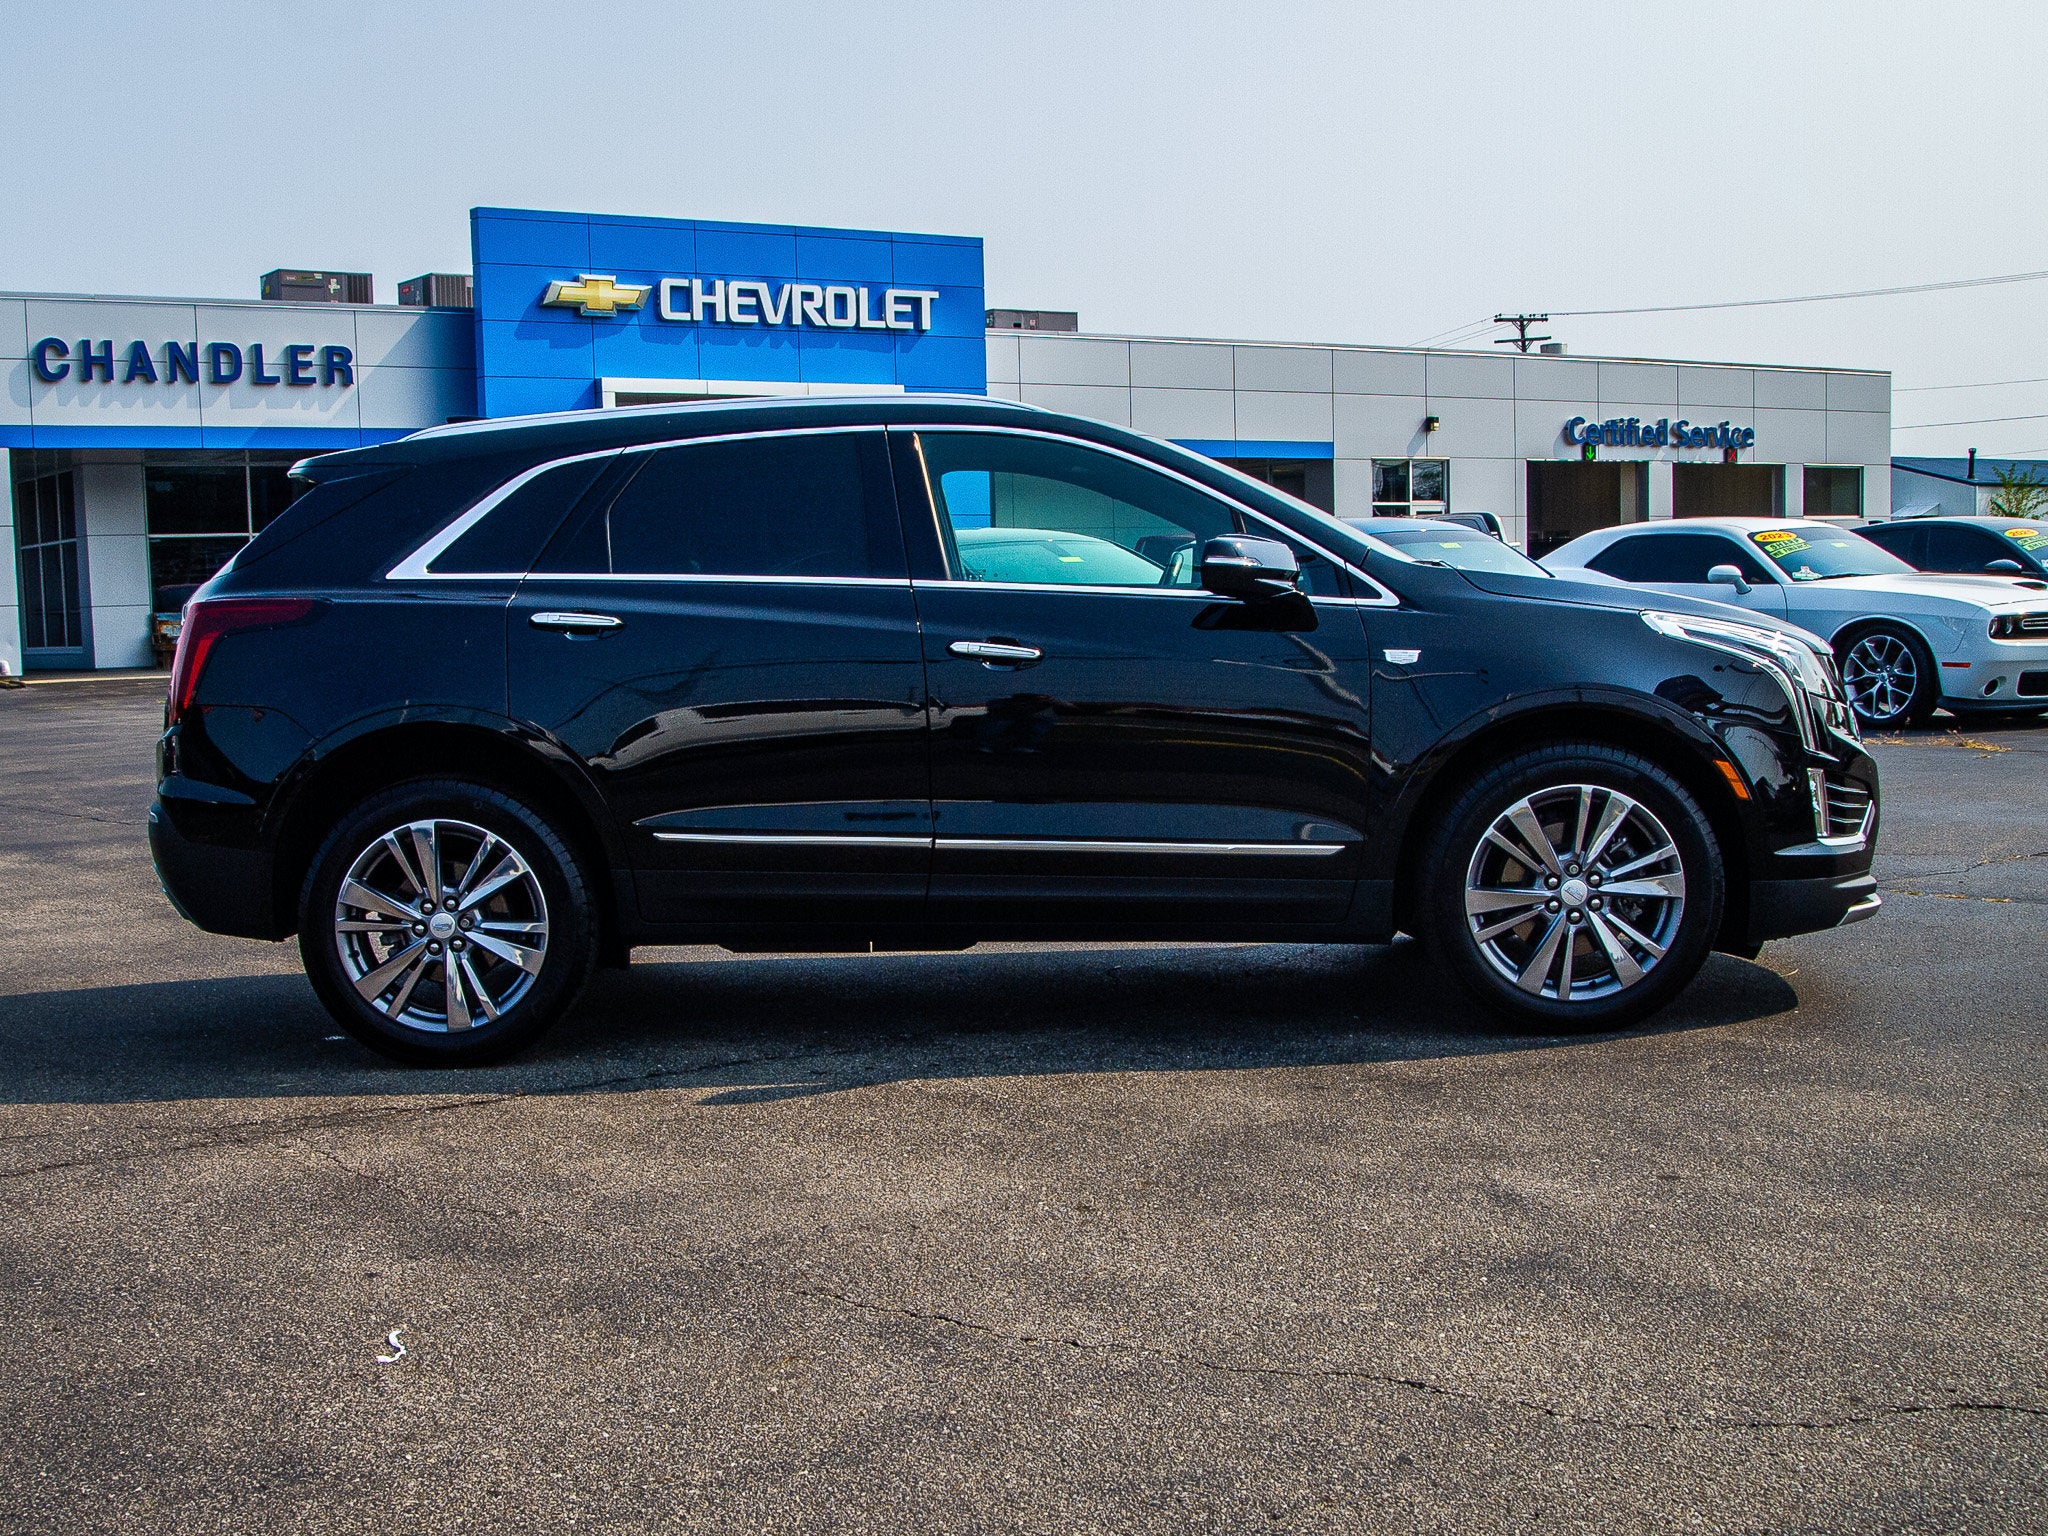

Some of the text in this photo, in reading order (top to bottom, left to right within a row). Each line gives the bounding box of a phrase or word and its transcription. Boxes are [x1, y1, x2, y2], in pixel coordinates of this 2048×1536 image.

[660, 278, 939, 331] CHEVROLET
[34, 337, 355, 386] CHANDLER
[1567, 416, 1755, 448] Certified Service
